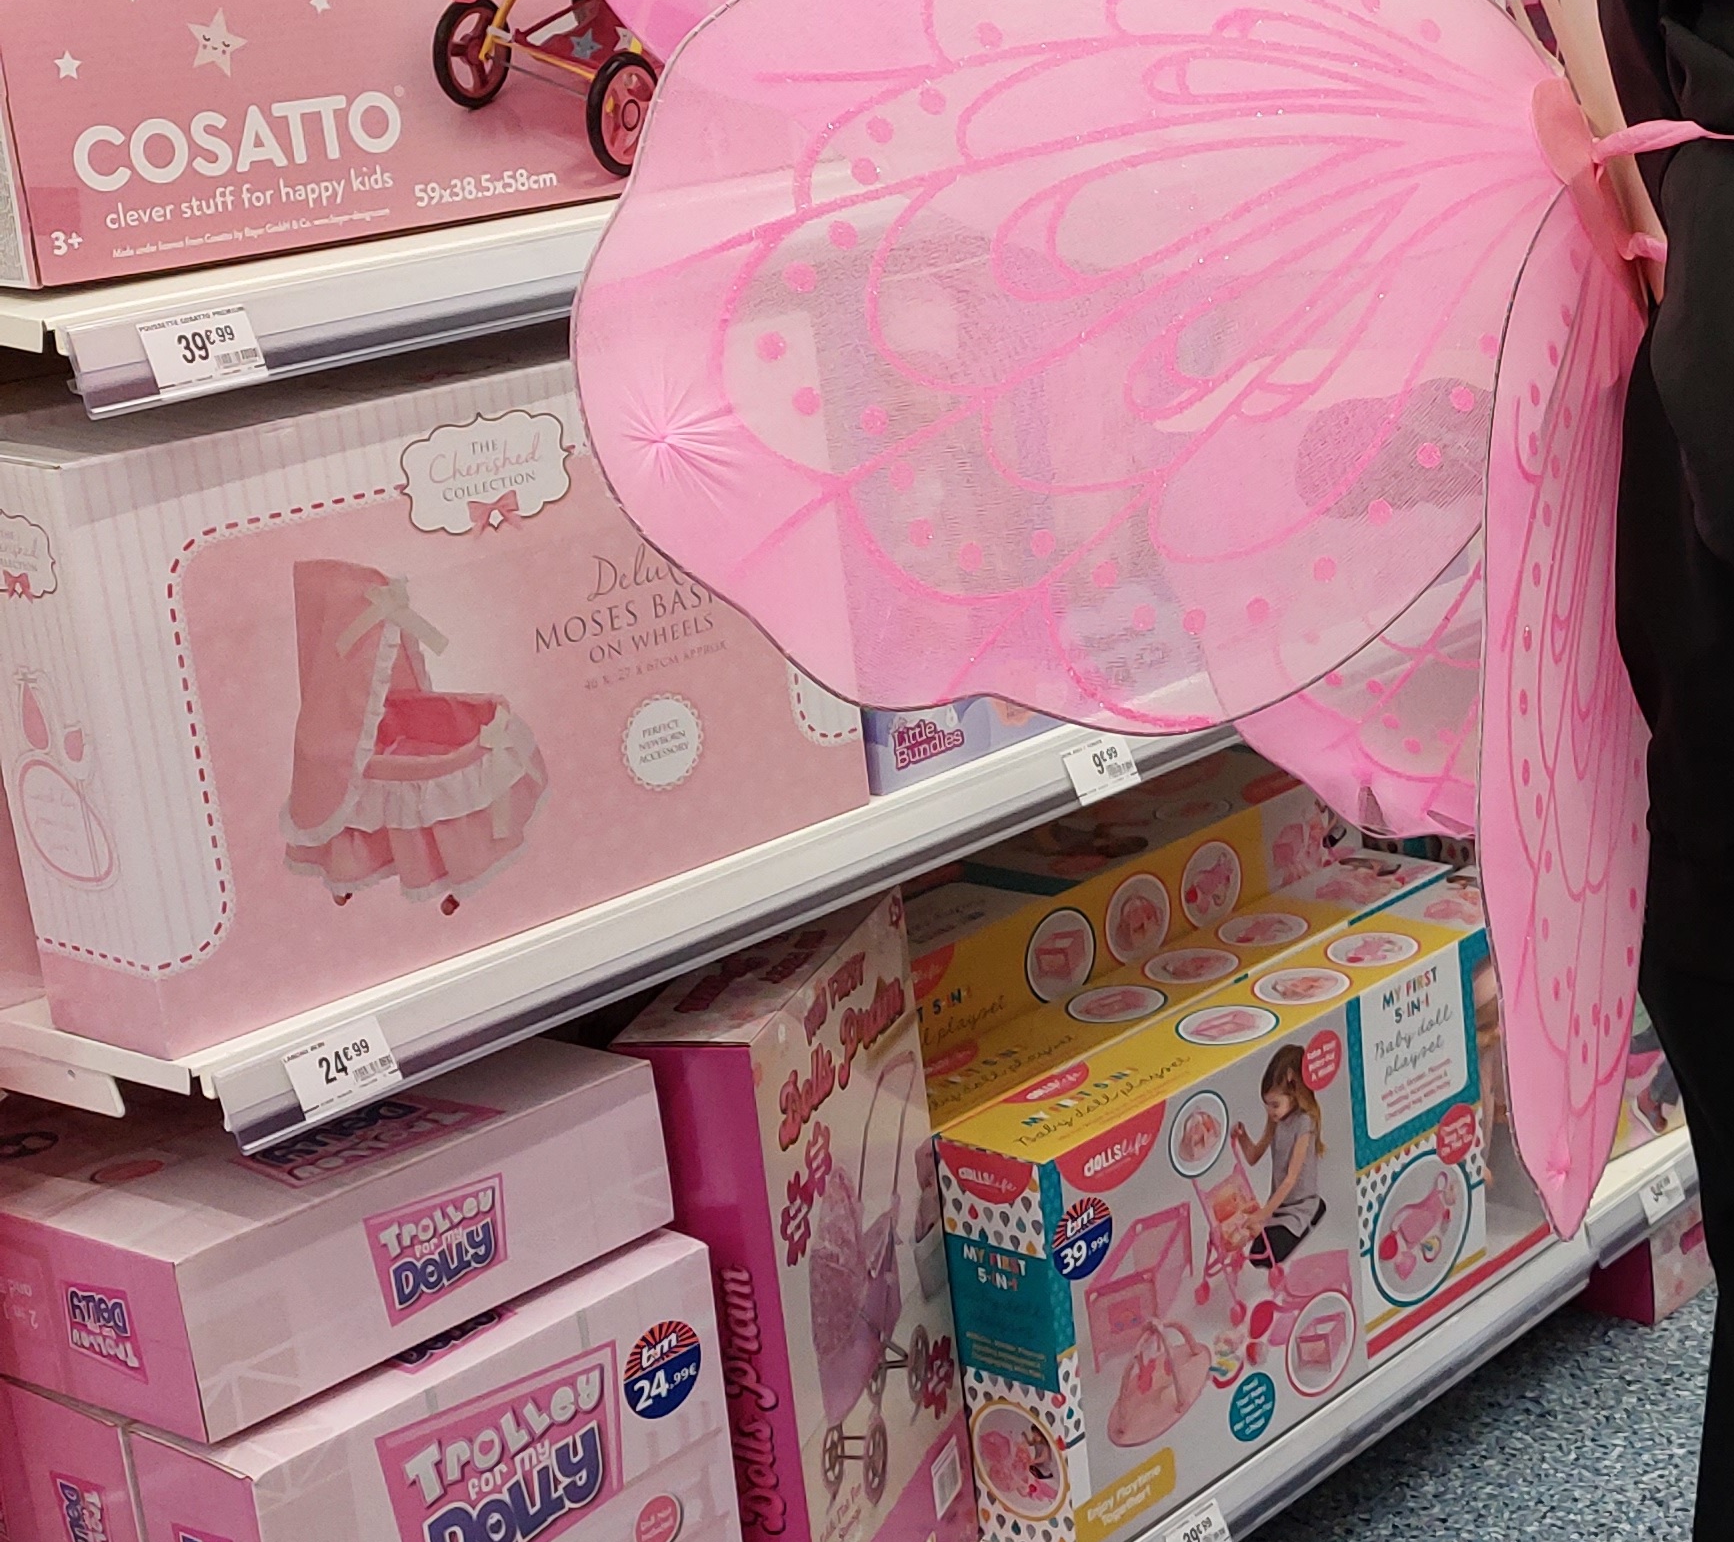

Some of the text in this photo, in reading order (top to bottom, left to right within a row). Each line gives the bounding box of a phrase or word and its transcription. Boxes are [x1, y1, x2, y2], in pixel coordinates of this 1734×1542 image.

[73, 89, 401, 193] COSATTO
[104, 164, 395, 231] clever stuff for happy kids
[414, 167, 557, 209] 59x38.5x58cm
[50, 229, 84, 257] 3+
[176, 324, 236, 365] 39€99
[429, 432, 540, 485] Cherished
[470, 439, 499, 456] THE
[442, 471, 537, 503] COLLECTION
[534, 599, 639, 654] MOSES
[589, 612, 715, 665] ON WHEELS
[641, 718, 681, 739] PERFECT
[893, 719, 937, 751] Little
[638, 741, 690, 766] ACCESSORY
[895, 731, 964, 769] Bundles
[1381, 965, 1439, 1011] MY FIRST
[1374, 1030, 1415, 1062] Baby
[1415, 1003, 1454, 1038] doll
[317, 1038, 371, 1086] 24€99
[963, 1242, 986, 1264] MY
[467, 1438, 552, 1501] for my
